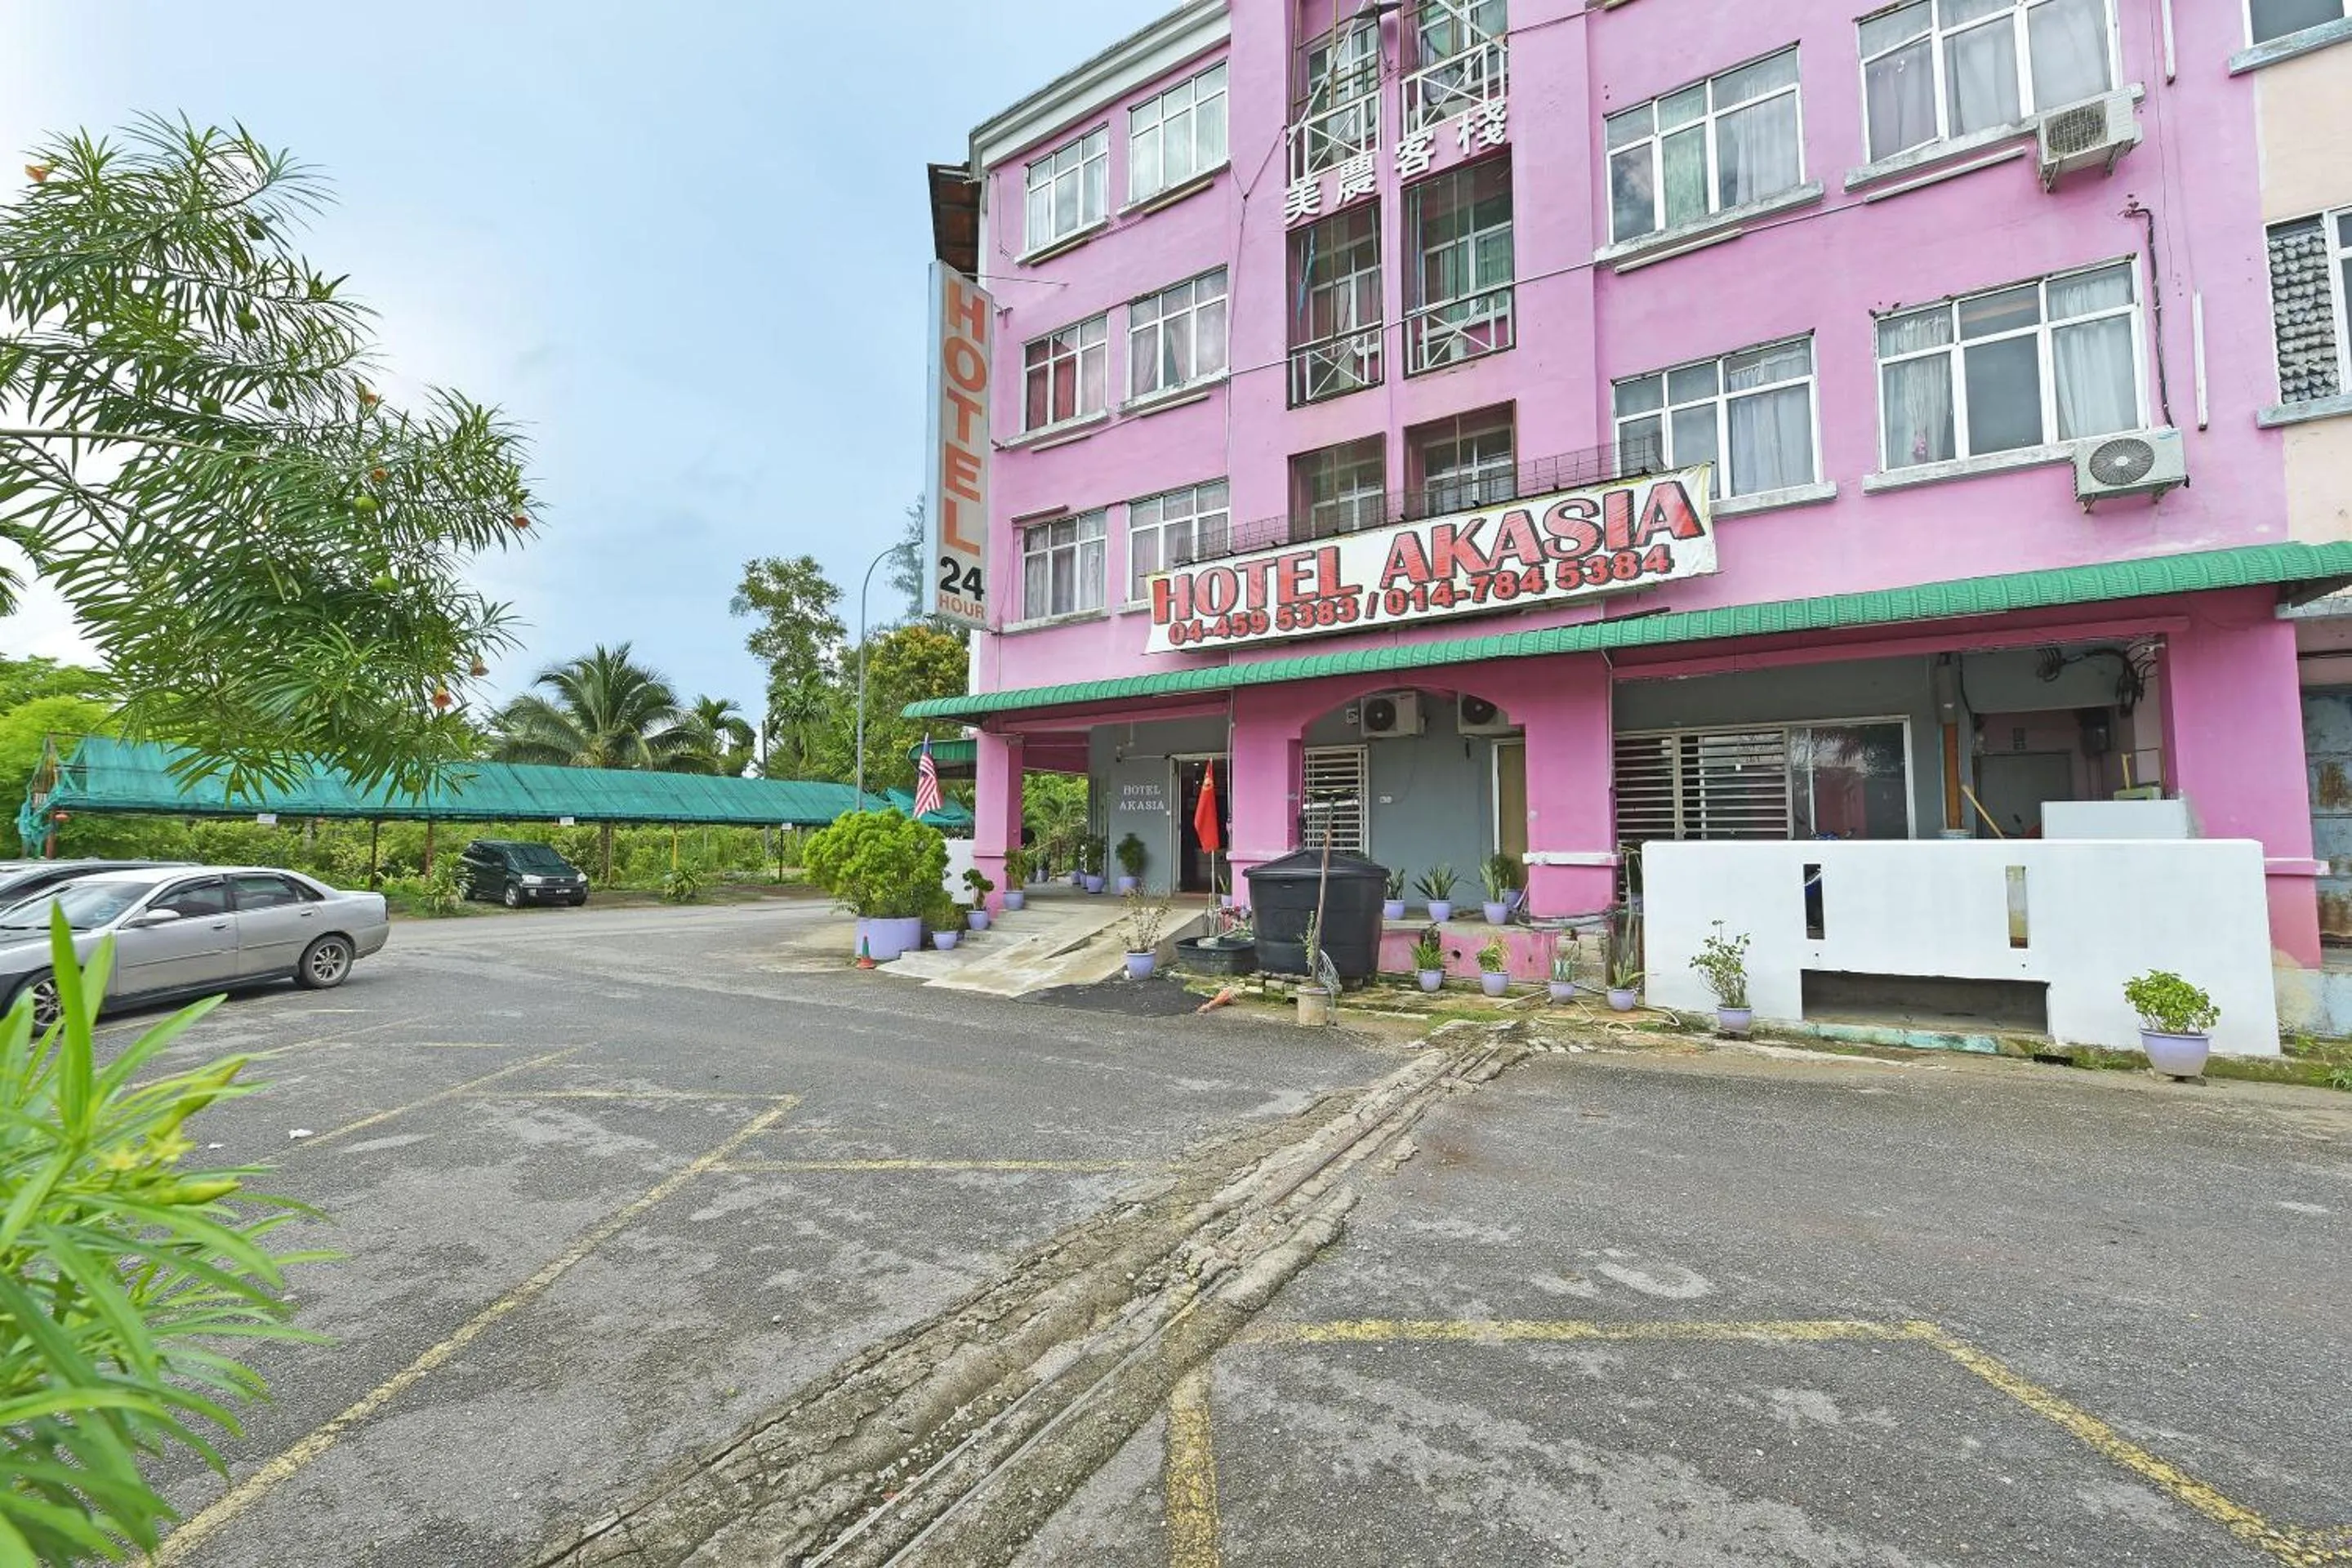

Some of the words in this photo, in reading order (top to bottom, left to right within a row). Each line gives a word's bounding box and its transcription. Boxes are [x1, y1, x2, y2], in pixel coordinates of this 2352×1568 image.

[943, 282, 987, 556] HOTEL
[1152, 545, 1363, 625] HOTEL
[1380, 480, 1706, 590] AKASIA
[939, 555, 985, 603] 24
[1168, 608, 1271, 646] 04-459
[1275, 596, 1360, 632] 5383
[1383, 565, 1548, 616] 014-784
[1555, 543, 1675, 590] 5384
[938, 594, 986, 620] HOUR
[1119, 800, 1165, 811] AKASIA
[1123, 785, 1162, 795] HOTEL
